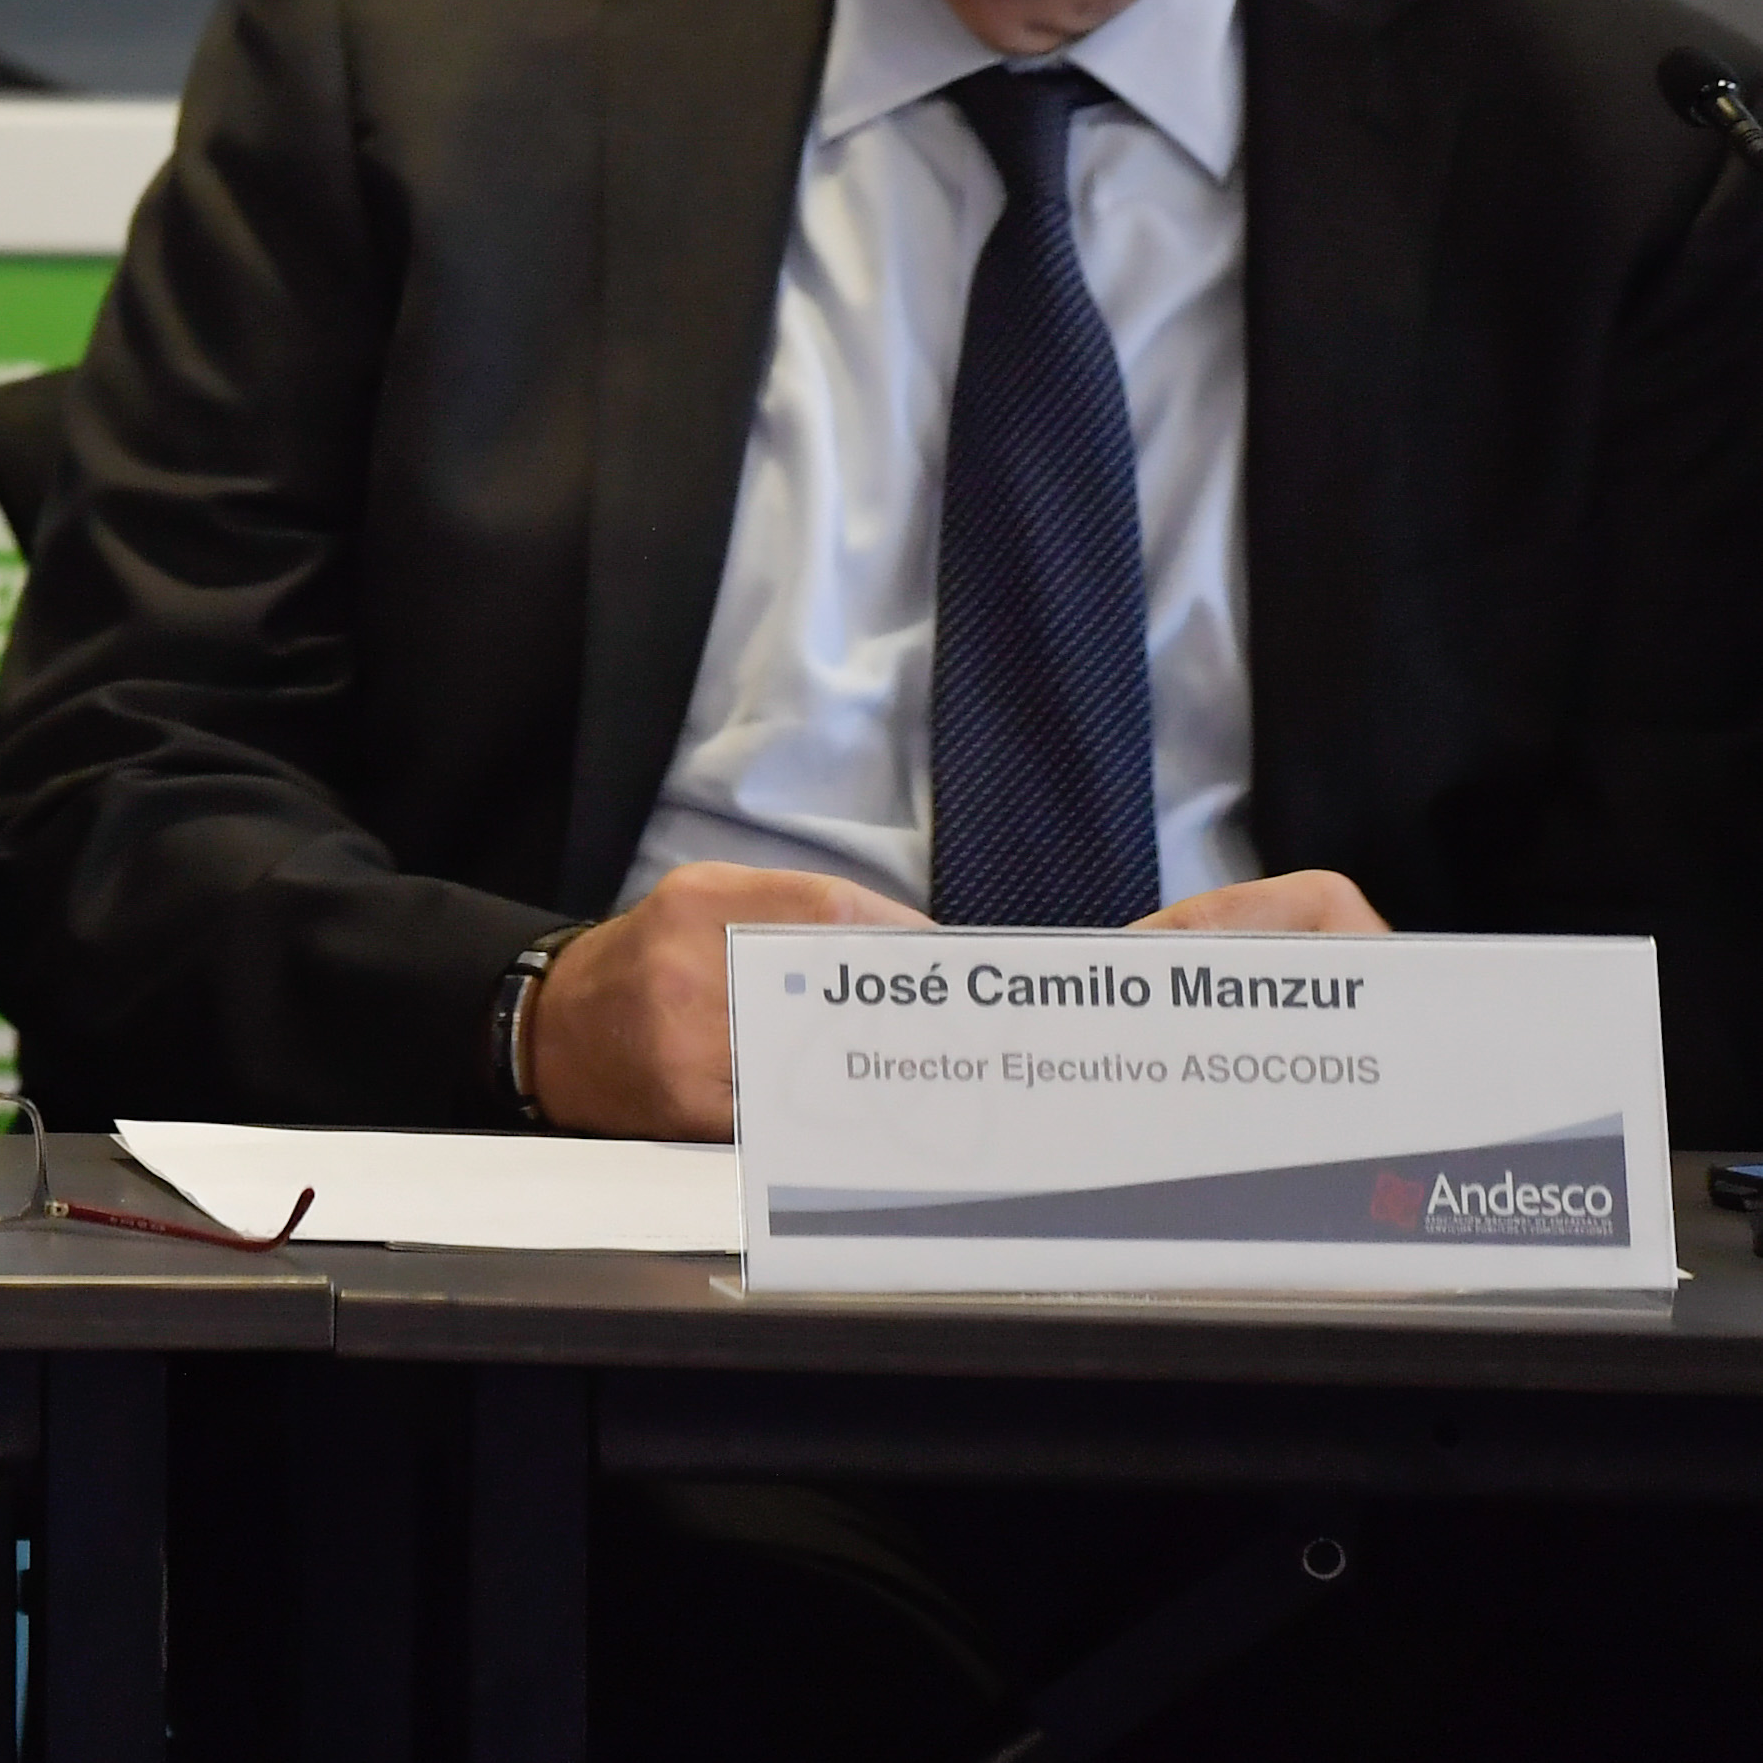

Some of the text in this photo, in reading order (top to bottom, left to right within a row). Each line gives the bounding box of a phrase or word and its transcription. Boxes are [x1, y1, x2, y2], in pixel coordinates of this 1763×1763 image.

[822, 959, 1366, 1010] José Camilo Manzur
[845, 1050, 1382, 1089] Director Ejecutivo ASOCODIS
[1427, 1170, 1614, 1216] Andesco
